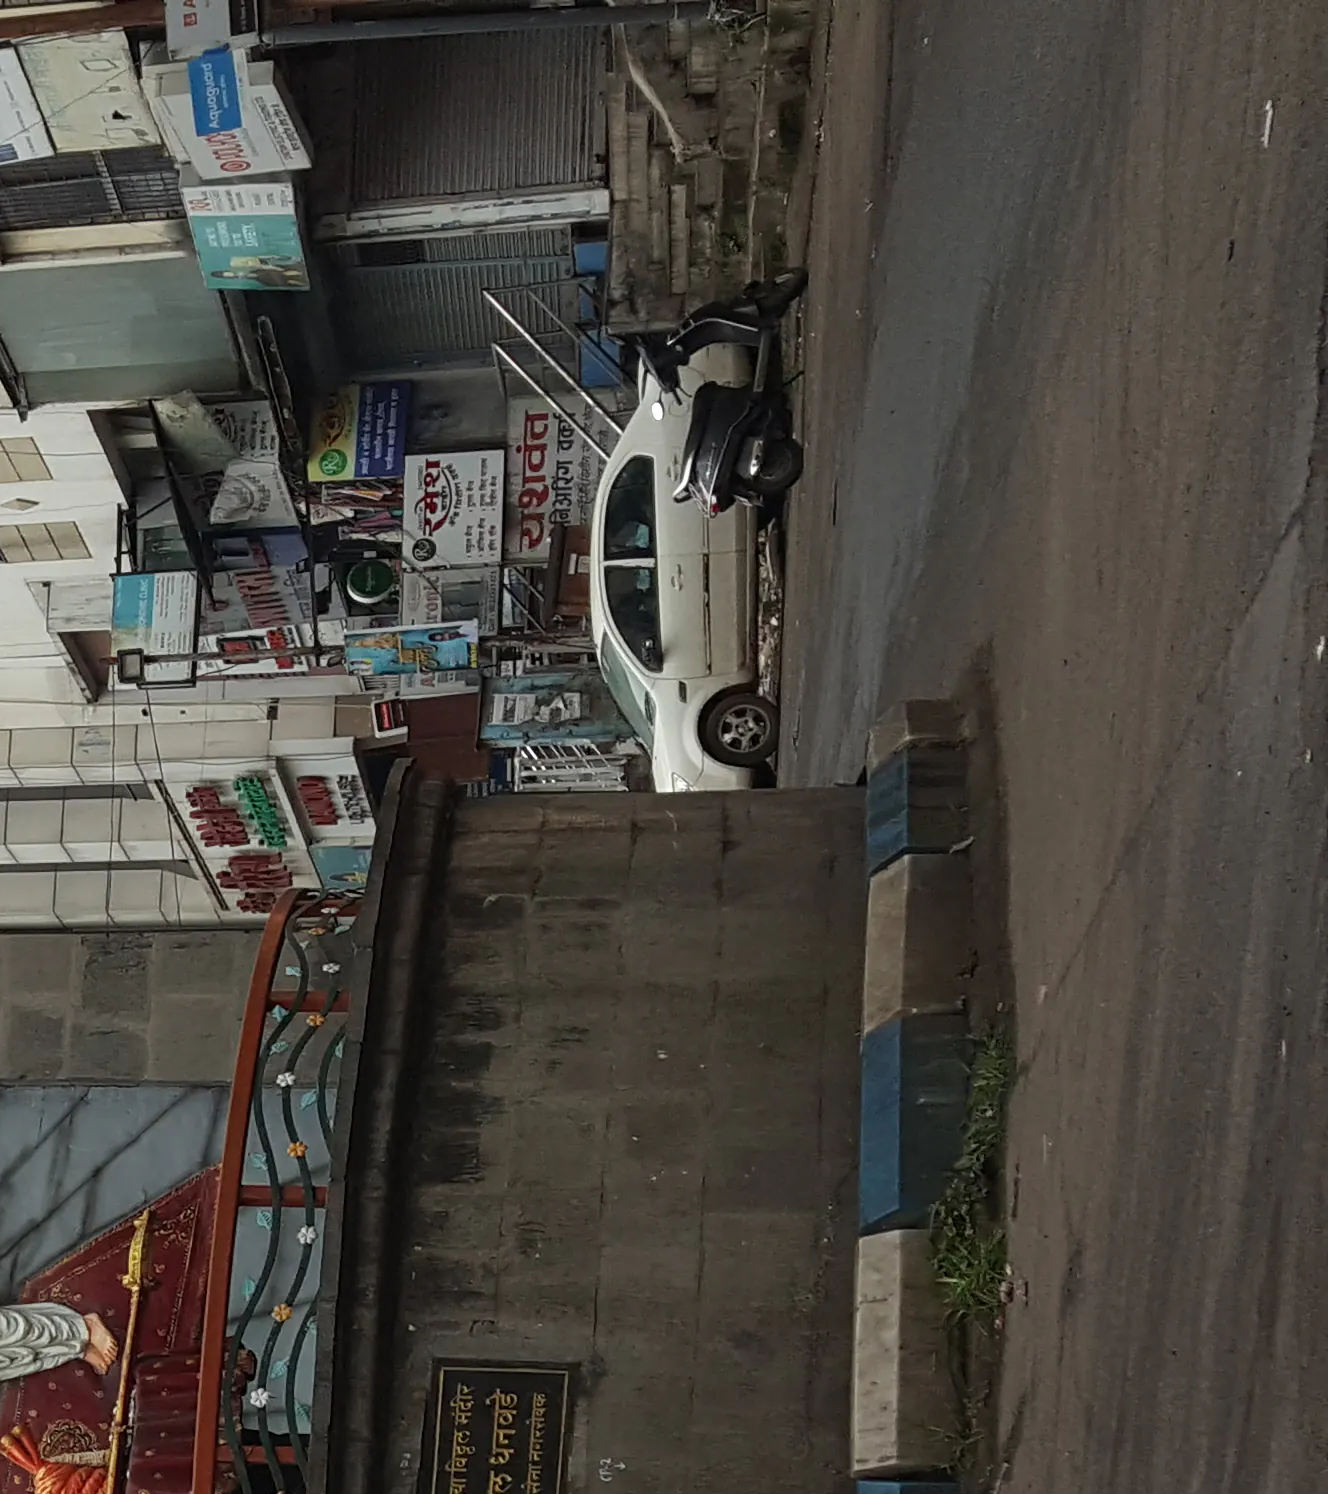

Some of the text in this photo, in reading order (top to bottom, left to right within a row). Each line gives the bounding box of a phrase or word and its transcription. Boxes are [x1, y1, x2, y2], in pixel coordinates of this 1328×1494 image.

[200, 62, 223, 129] Aquaguard
[414, 459, 448, 537] रमेश
[516, 409, 550, 552] यशवंत
[485, 1388, 519, 1465] धनवडे
[525, 1391, 549, 1461] नगरसेवक
